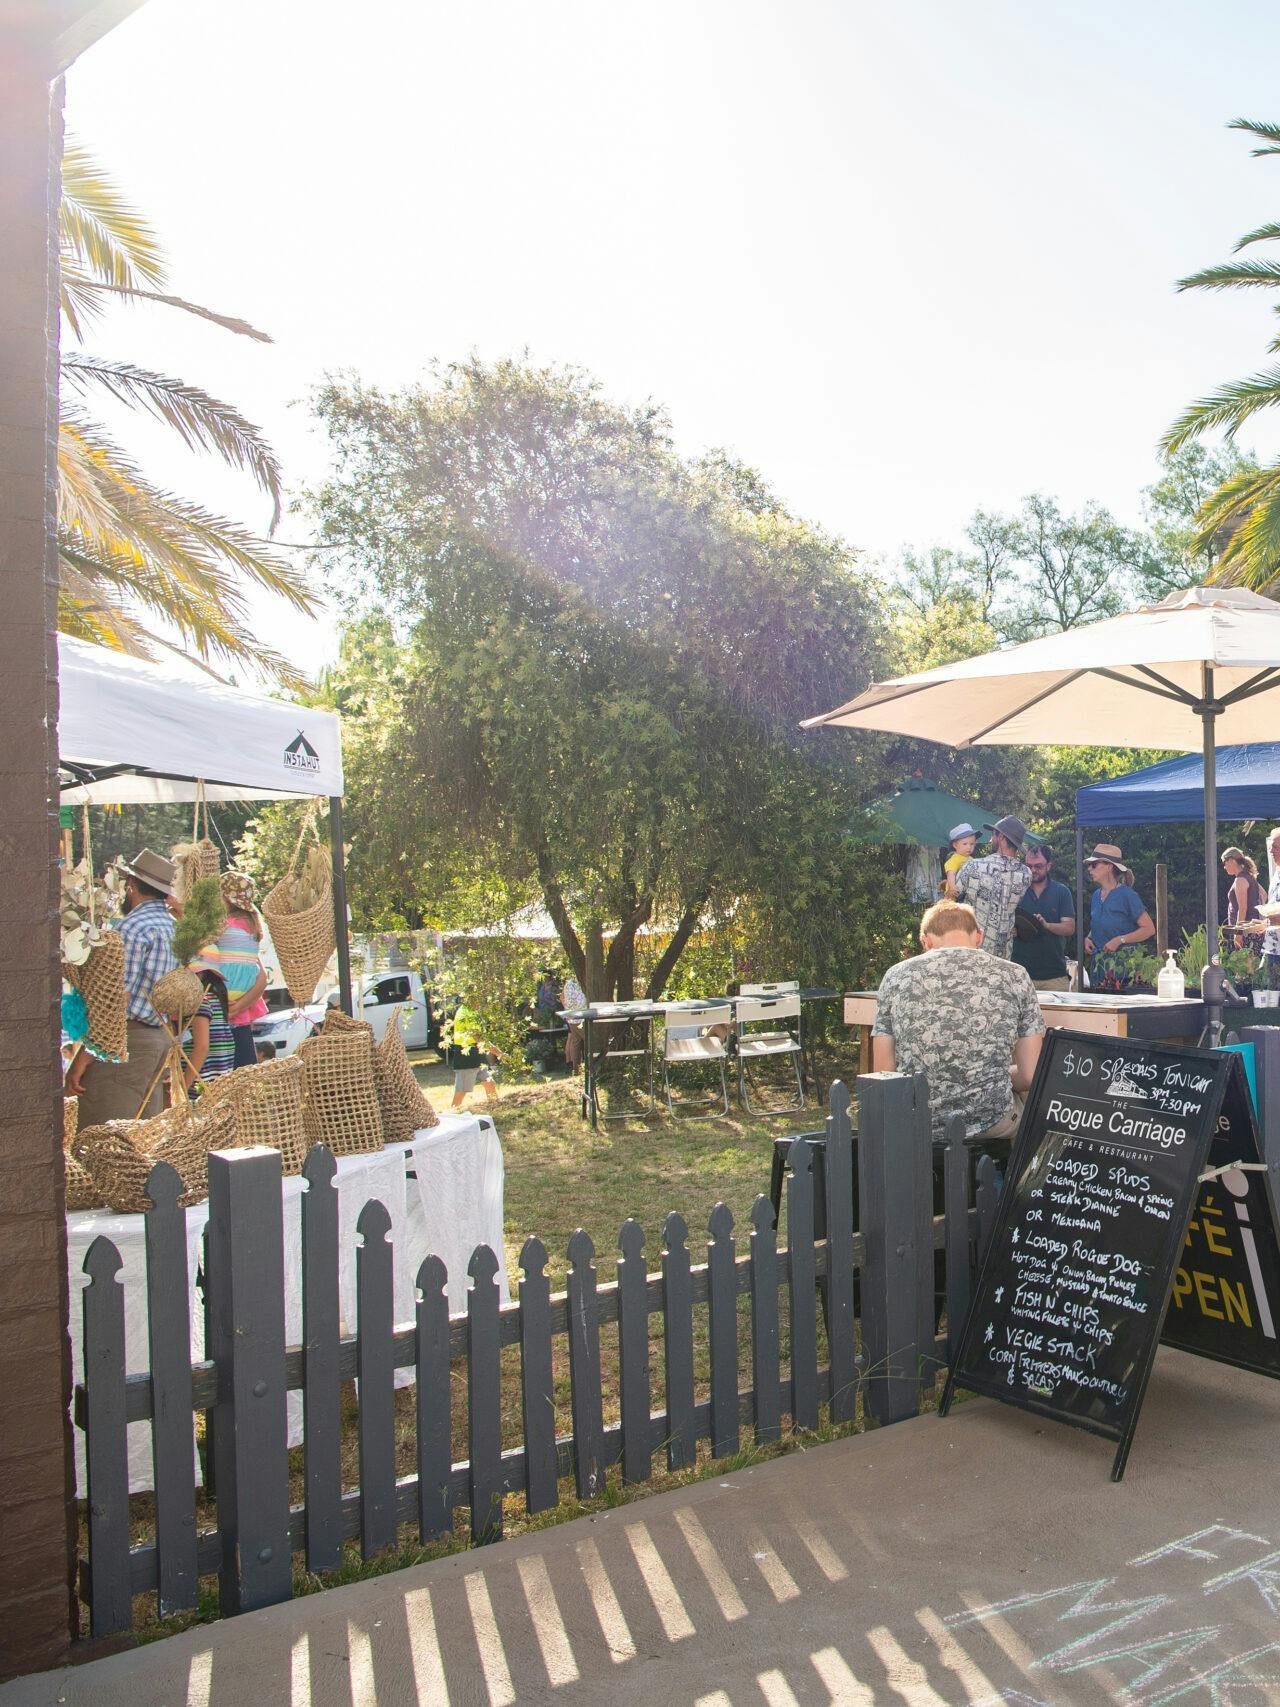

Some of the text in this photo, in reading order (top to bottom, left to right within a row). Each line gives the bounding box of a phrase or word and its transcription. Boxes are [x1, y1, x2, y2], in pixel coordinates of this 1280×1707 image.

[283, 752, 320, 770] INSTAHUT
[1063, 1050, 1093, 1077] $10
[1163, 1063, 1213, 1093] TONIGHT
[1112, 1100, 1129, 1110] THE
[1045, 1099, 1104, 1131] Rogue
[1108, 1111, 1187, 1148] Carriage
[1062, 1138, 1083, 1150] CAFE
[1099, 1144, 1155, 1162] RESTAURANT
[1046, 1173, 1078, 1196] CREAMY
[1047, 1154, 1151, 1192] LOADED SPUDS
[1031, 1189, 1121, 1217] OR STEAK DIANNE
[1026, 1209, 1101, 1232] OR MEXICANA
[1025, 1230, 1142, 1276] LOADED ROGUE DOG
[1056, 1277, 1091, 1295] MUSTARD
[1168, 1270, 1252, 1328] PEN
[1014, 1282, 1043, 1308] FISH
[1063, 1301, 1100, 1326] CHIPS
[1006, 1325, 1097, 1370] VEGIE STACK
[1083, 1323, 1114, 1346] CHIPS
[989, 1347, 1017, 1363] CORN
